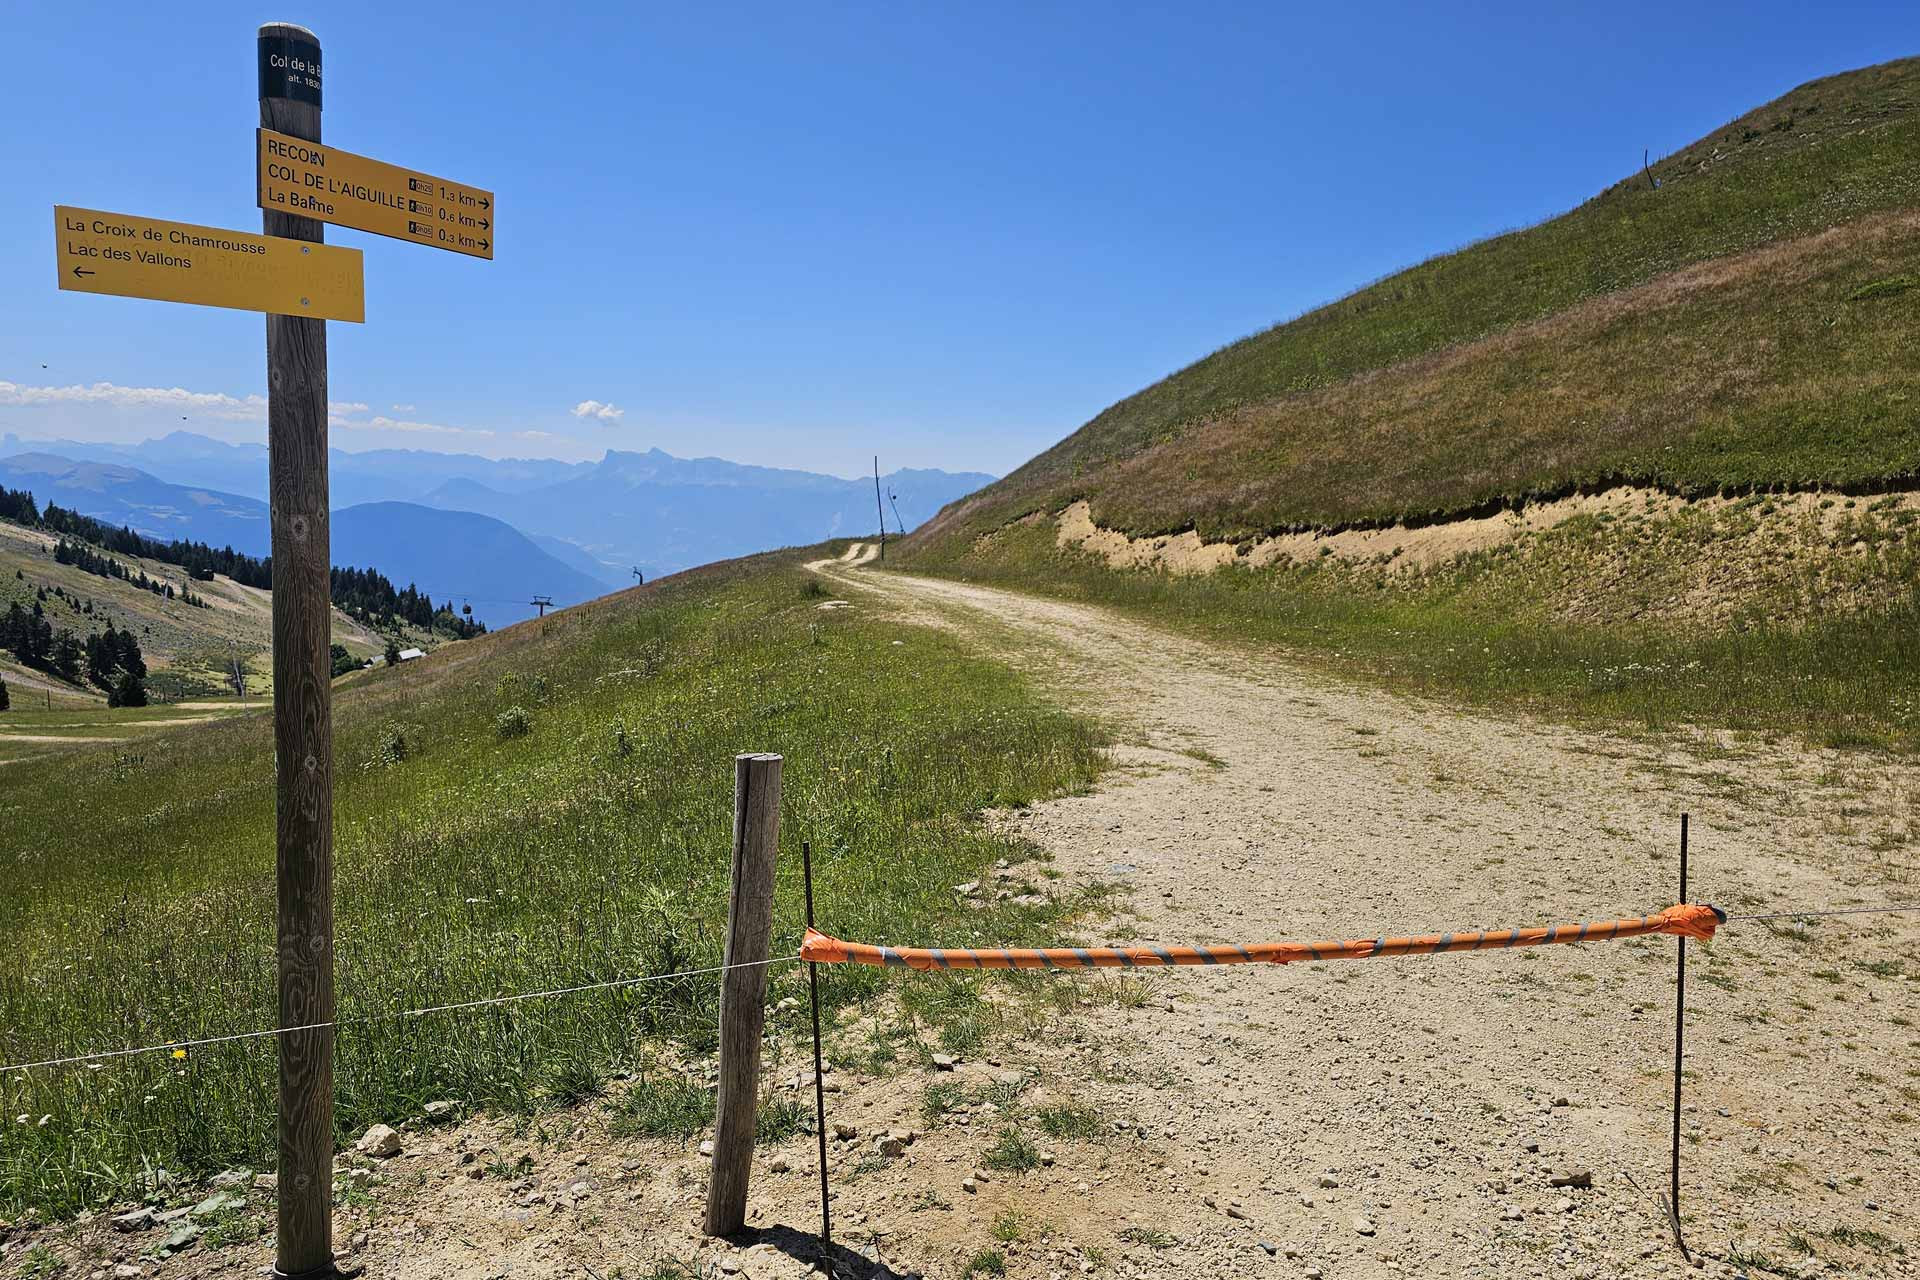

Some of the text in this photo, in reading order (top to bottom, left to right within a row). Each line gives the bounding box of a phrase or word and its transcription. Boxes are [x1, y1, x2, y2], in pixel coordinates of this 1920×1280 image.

[270, 54, 288, 68] Col
[291, 57, 305, 71] de
[307, 60, 315, 75] la
[288, 74, 302, 84] alt.
[268, 163, 405, 210] COL DE L'AIGUILLE
[268, 186, 285, 203] La
[439, 186, 455, 202] 1.3
[459, 191, 476, 208] km
[438, 207, 455, 223] 0.6
[459, 212, 476, 228] km
[66, 217, 266, 255] La Croix de Chamrousse
[438, 228, 455, 243] 0.3
[459, 232, 475, 249] km
[68, 241, 192, 269] Lac des Vallons
